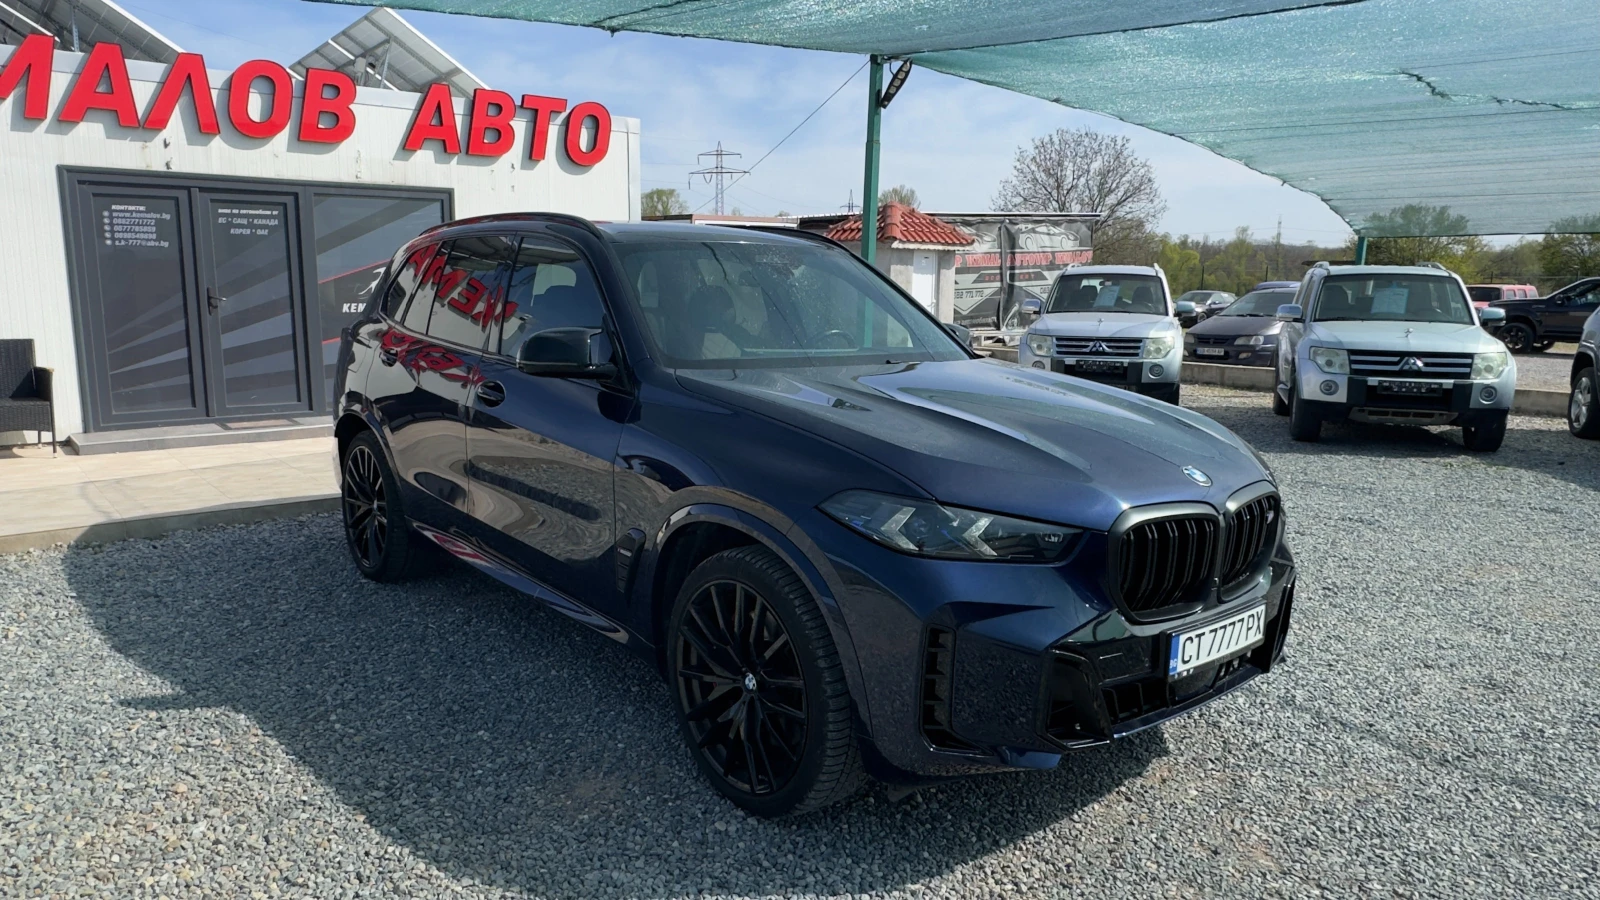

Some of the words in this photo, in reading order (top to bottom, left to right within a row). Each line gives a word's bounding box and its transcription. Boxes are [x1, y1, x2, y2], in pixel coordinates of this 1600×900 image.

[403, 82, 613, 168] АВТО
[232, 217, 248, 225] САЩ
[253, 218, 279, 226] КАНАДА
[1181, 609, 1264, 665] CT7777PX
